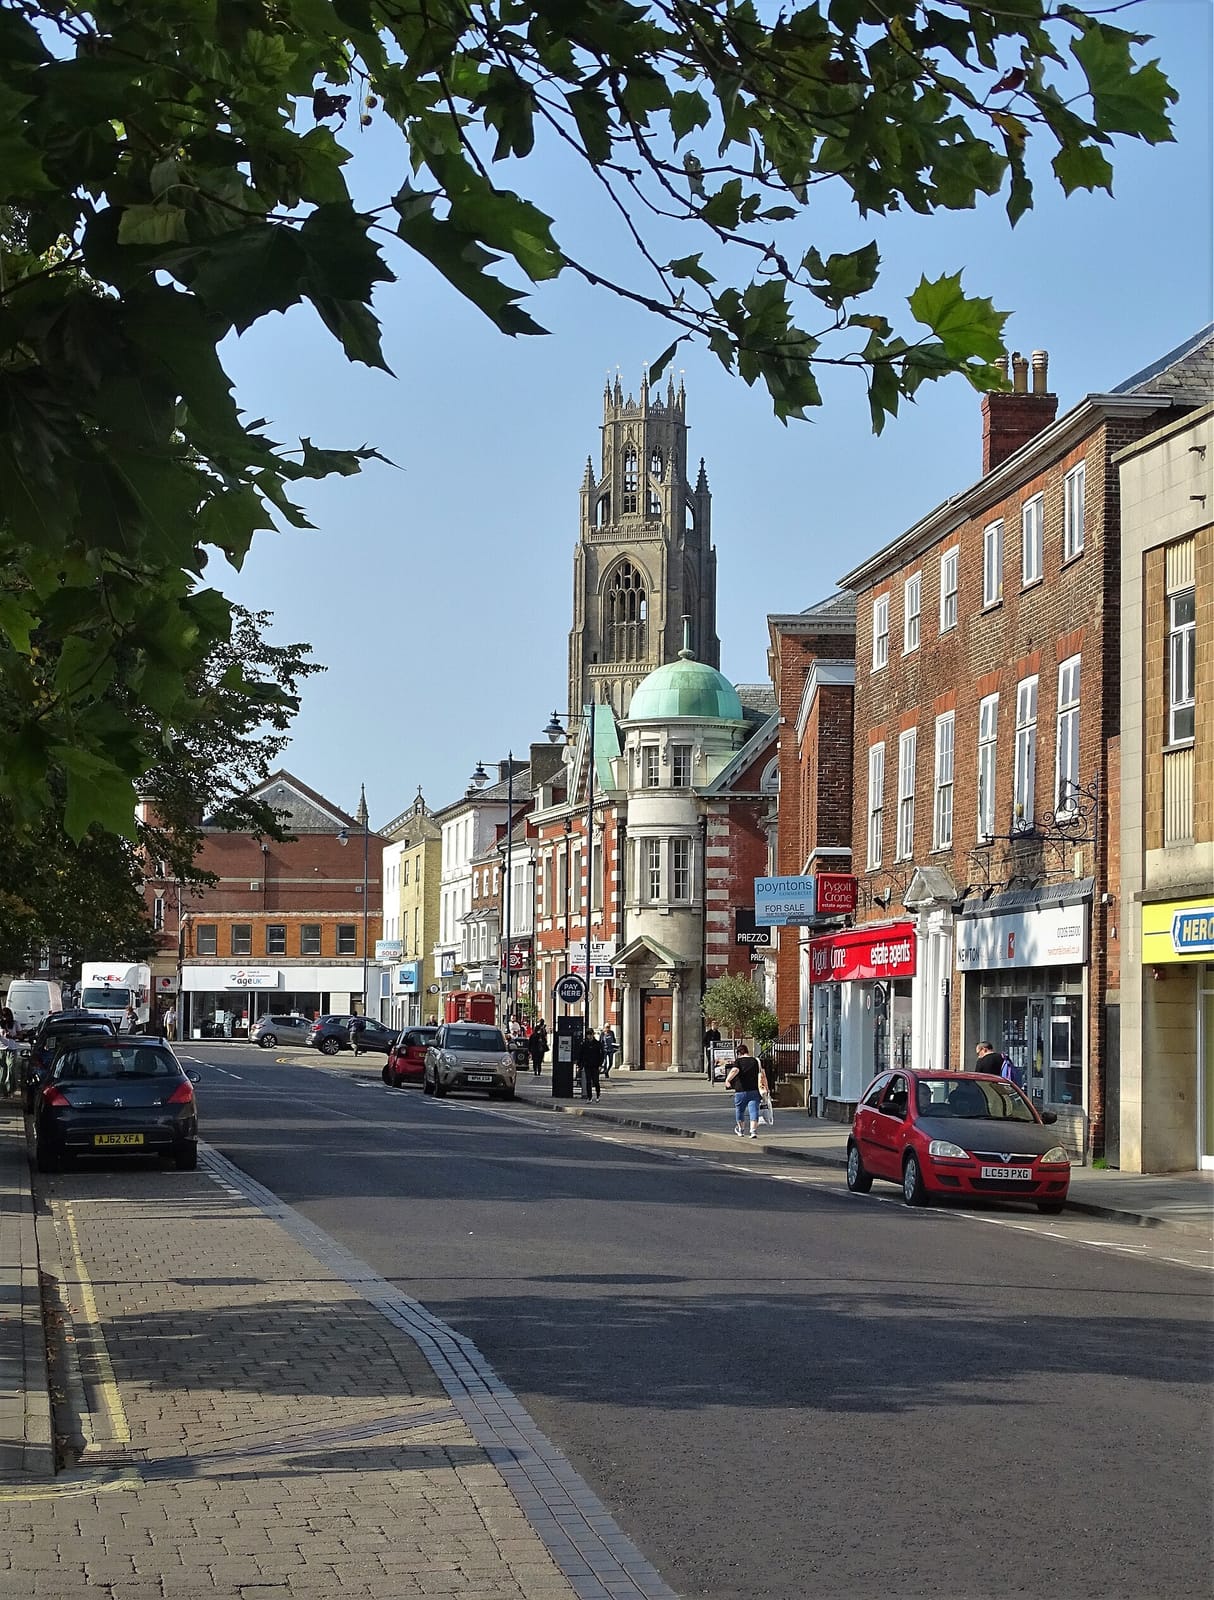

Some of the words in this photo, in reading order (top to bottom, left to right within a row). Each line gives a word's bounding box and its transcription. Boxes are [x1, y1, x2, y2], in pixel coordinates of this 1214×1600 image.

[757, 880, 813, 895] poyntons
[824, 881, 851, 893] Pygott
[825, 892, 852, 902] Crone
[765, 904, 782, 912] FOR
[784, 903, 805, 912] SALE
[737, 933, 769, 943] PREZZO
[830, 944, 846, 969] Crone
[870, 941, 888, 967] estate
[888, 938, 911, 968] agents
[958, 947, 980, 963] NEWTON
[92, 974, 124, 983] FedEx
[98, 1135, 121, 1145] AJ62
[123, 1135, 140, 1144] XFA
[985, 1168, 1009, 1178] LC53
[1011, 1169, 1029, 1179] PXG
